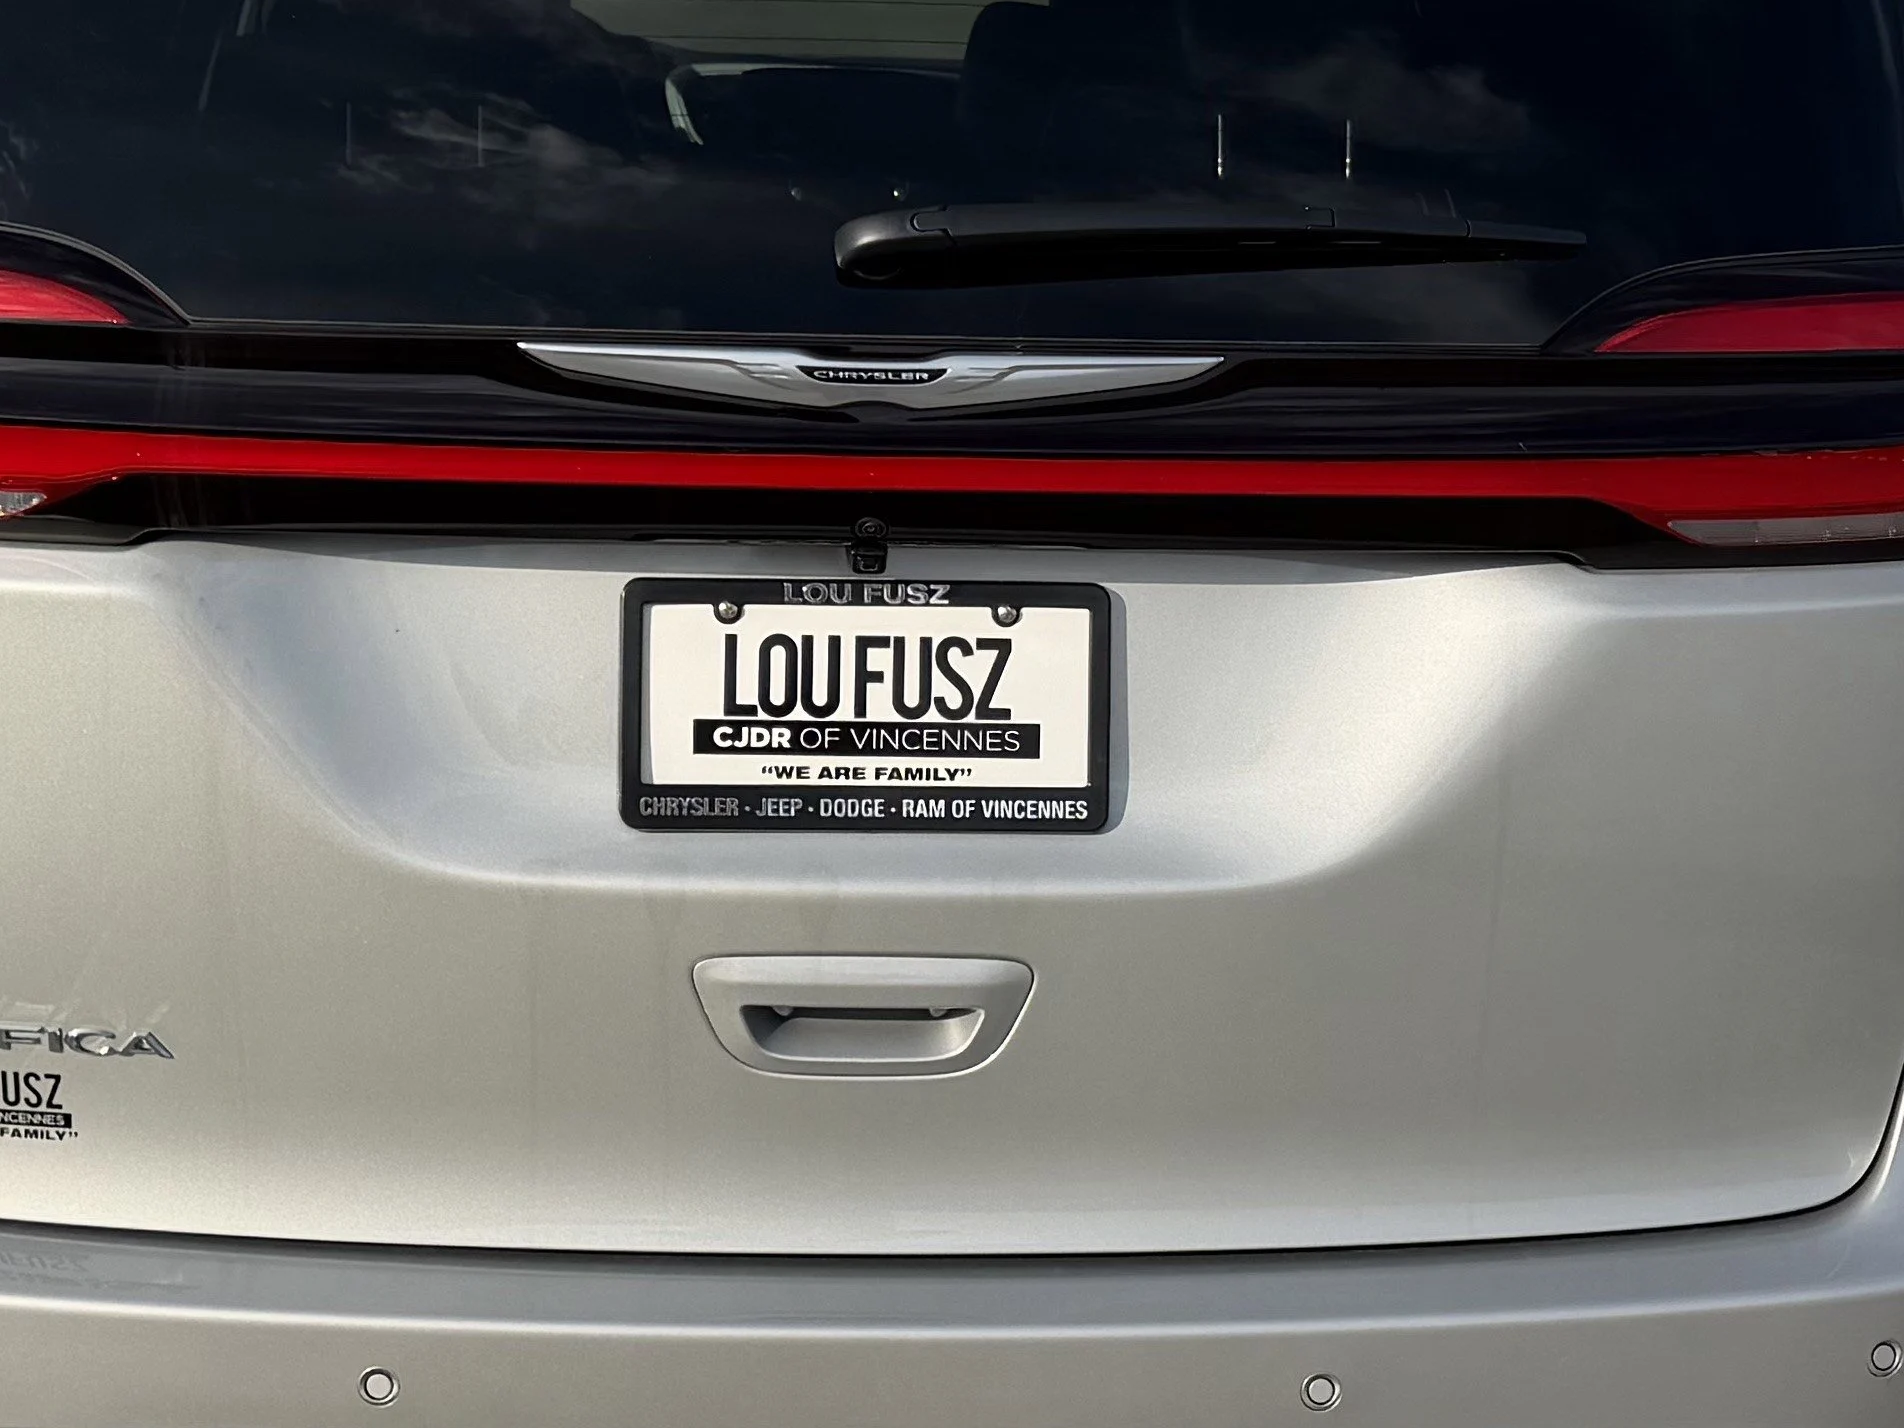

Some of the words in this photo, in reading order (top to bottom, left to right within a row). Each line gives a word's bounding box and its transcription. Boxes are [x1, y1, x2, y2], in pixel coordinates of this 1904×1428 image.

[813, 369, 930, 381] CHRYSLER
[783, 582, 853, 605] LOU
[863, 583, 951, 605] FUSZ
[723, 633, 841, 719] LOU
[853, 635, 1013, 721] FUSZ
[712, 725, 792, 749] CJDR
[799, 727, 841, 750] OF
[849, 727, 1021, 752] VINCENNES
[817, 766, 866, 781] ARE
[638, 796, 740, 817] CHRYSLER
[755, 797, 803, 817] JEEP
[819, 798, 886, 818] DODGE
[902, 798, 946, 818] RAM
[951, 799, 976, 819] OF
[981, 799, 1089, 820] VINCENNES
